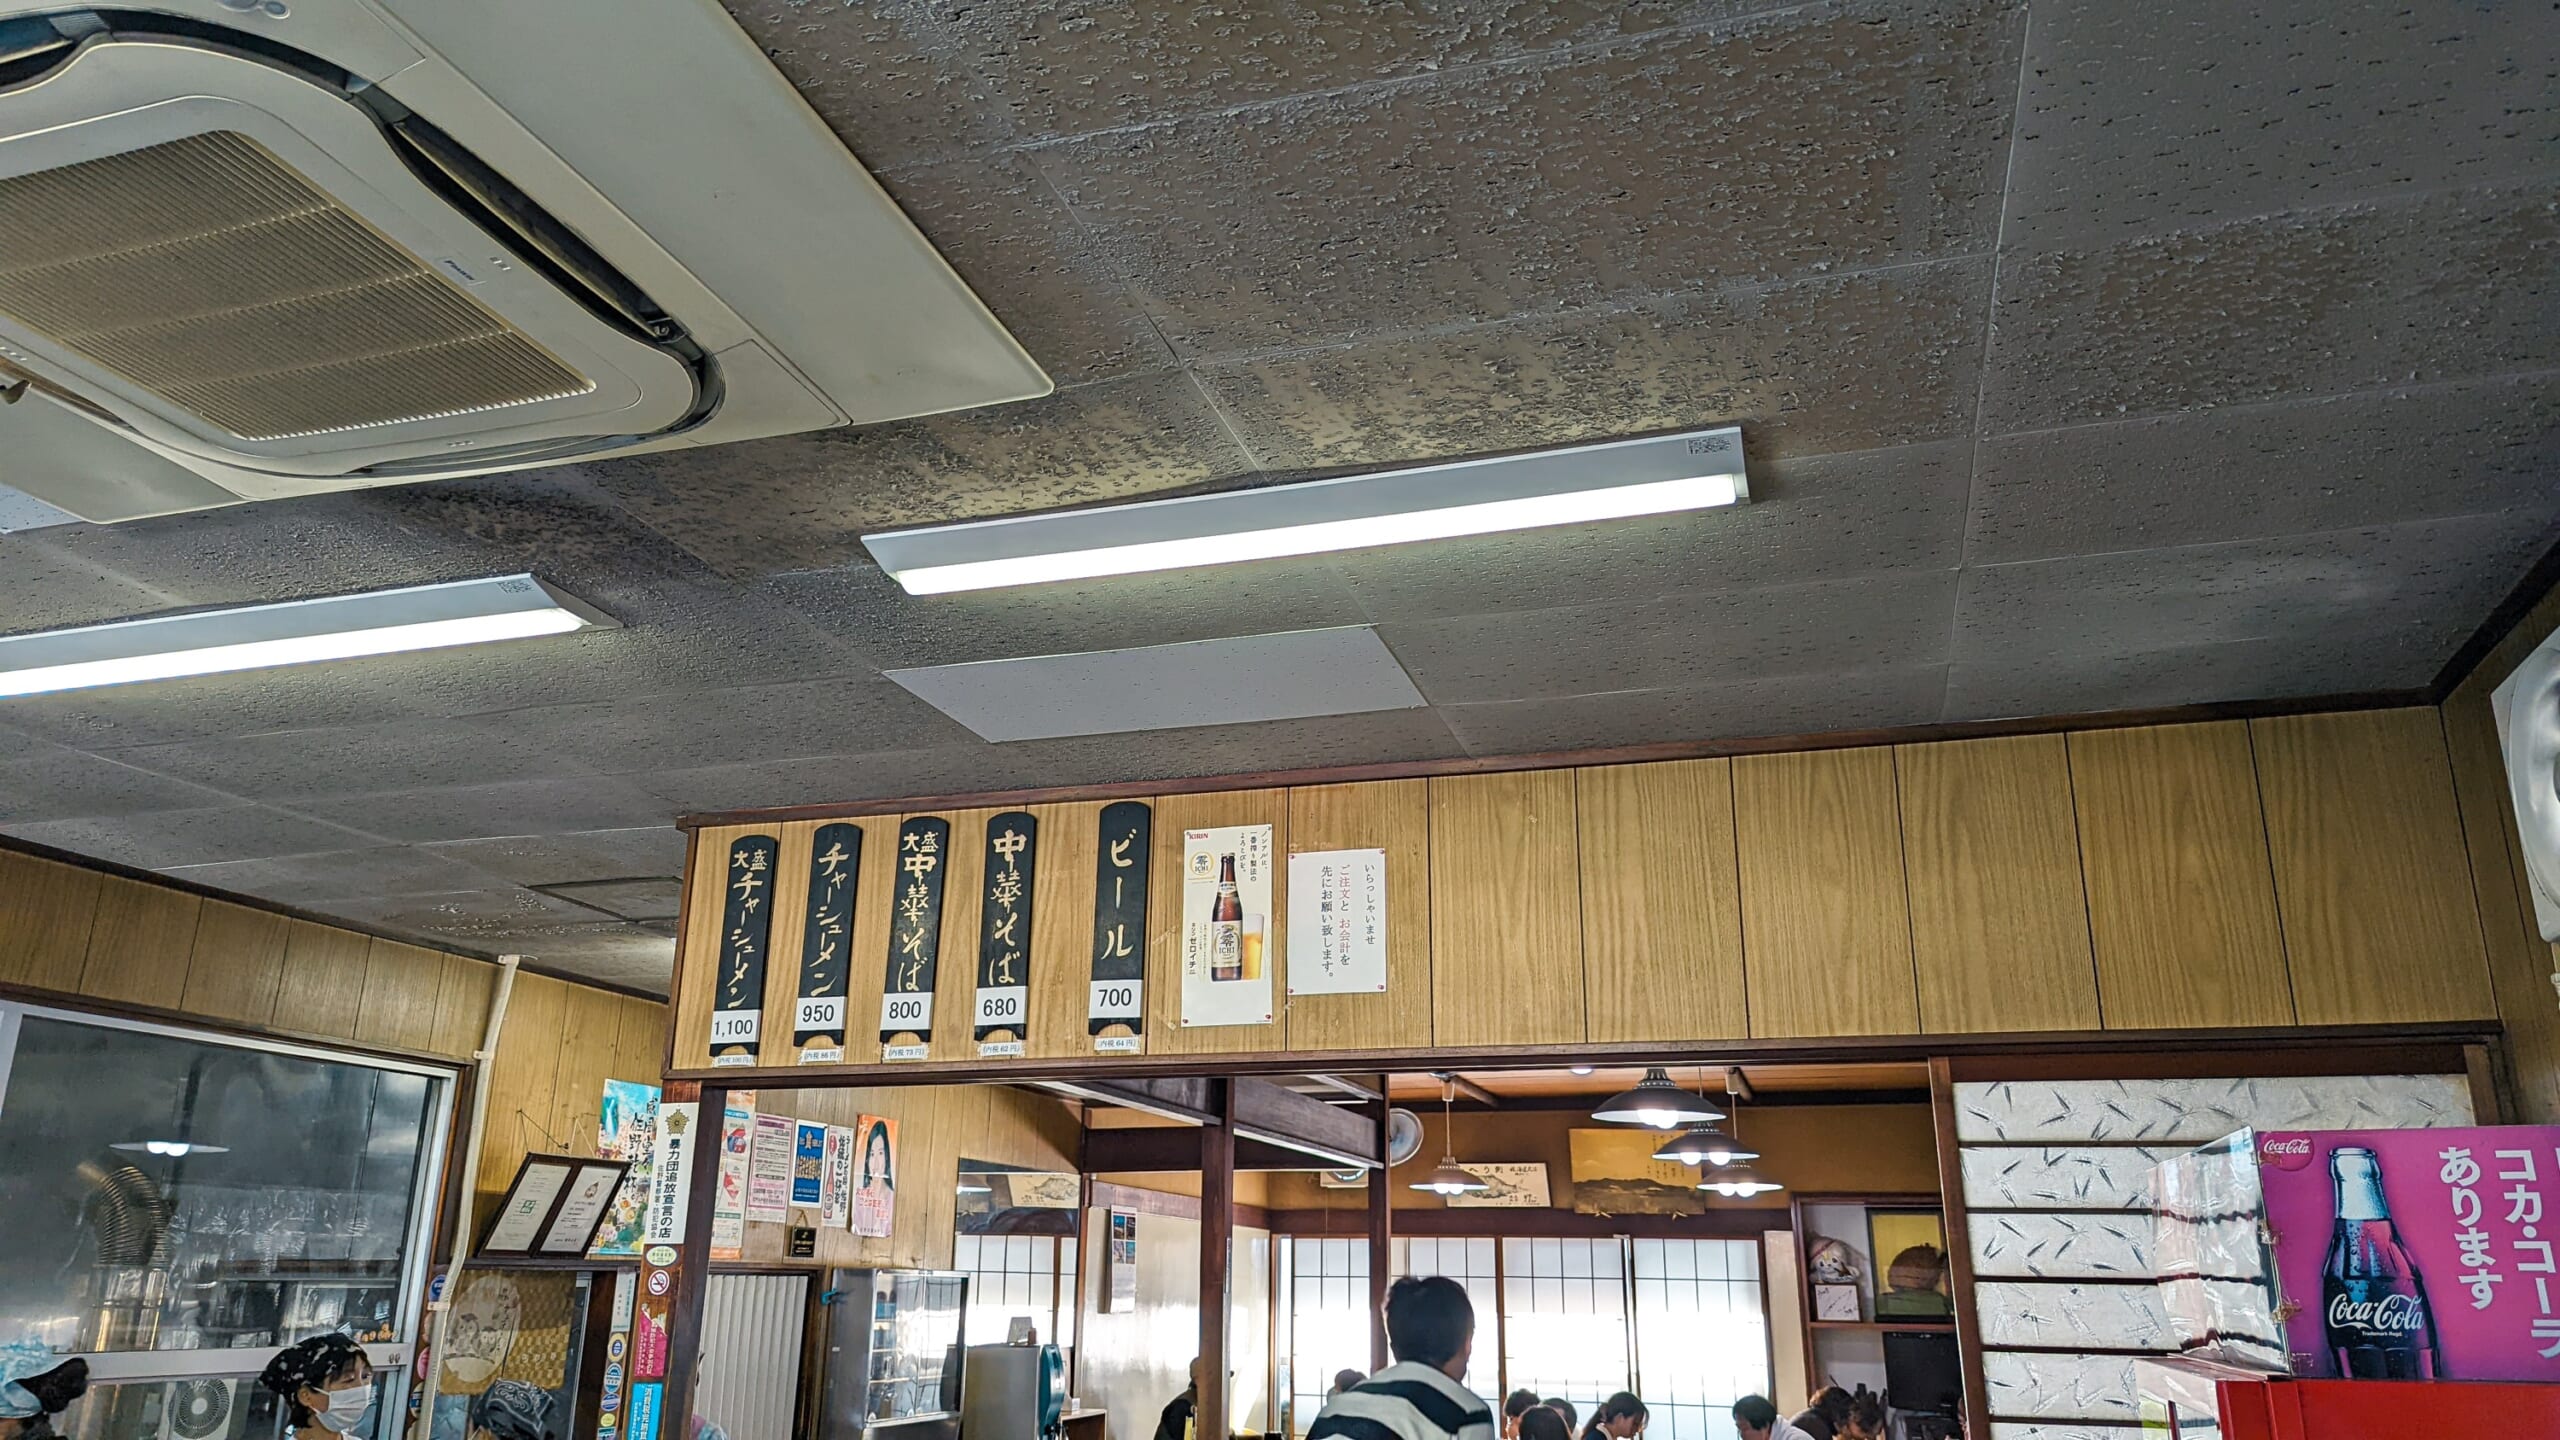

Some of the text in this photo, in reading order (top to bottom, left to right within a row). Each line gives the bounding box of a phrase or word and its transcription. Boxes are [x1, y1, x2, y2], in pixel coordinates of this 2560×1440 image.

[733, 849, 767, 871] 大盛
[903, 832, 938, 853] 大盛
[1189, 832, 1209, 840] KIRIN
[809, 843, 850, 996] チャーシューメン
[897, 853, 937, 992] 中華そば
[988, 830, 1027, 985] 中華そば
[1101, 827, 1137, 960] ビール
[1321, 866, 1334, 977] 先にお願い致します。
[1339, 864, 1351, 966] ご注文と お会計を
[1364, 864, 1376, 945] いらっしゃいませ
[725, 872, 763, 1009] チャーシューメン
[714, 1018, 753, 1036] 1,100
[802, 1005, 834, 1023] 950
[889, 1001, 921, 1019] 800
[983, 998, 1016, 1017] 680
[1098, 988, 1131, 1007] 700
[2263, 1138, 2311, 1154] Coca-Cola
[658, 1138, 681, 1239] 暴力団追放宣言の店
[2439, 1146, 2502, 1309] あります
[2329, 1293, 2424, 1330] Coca-Cola
